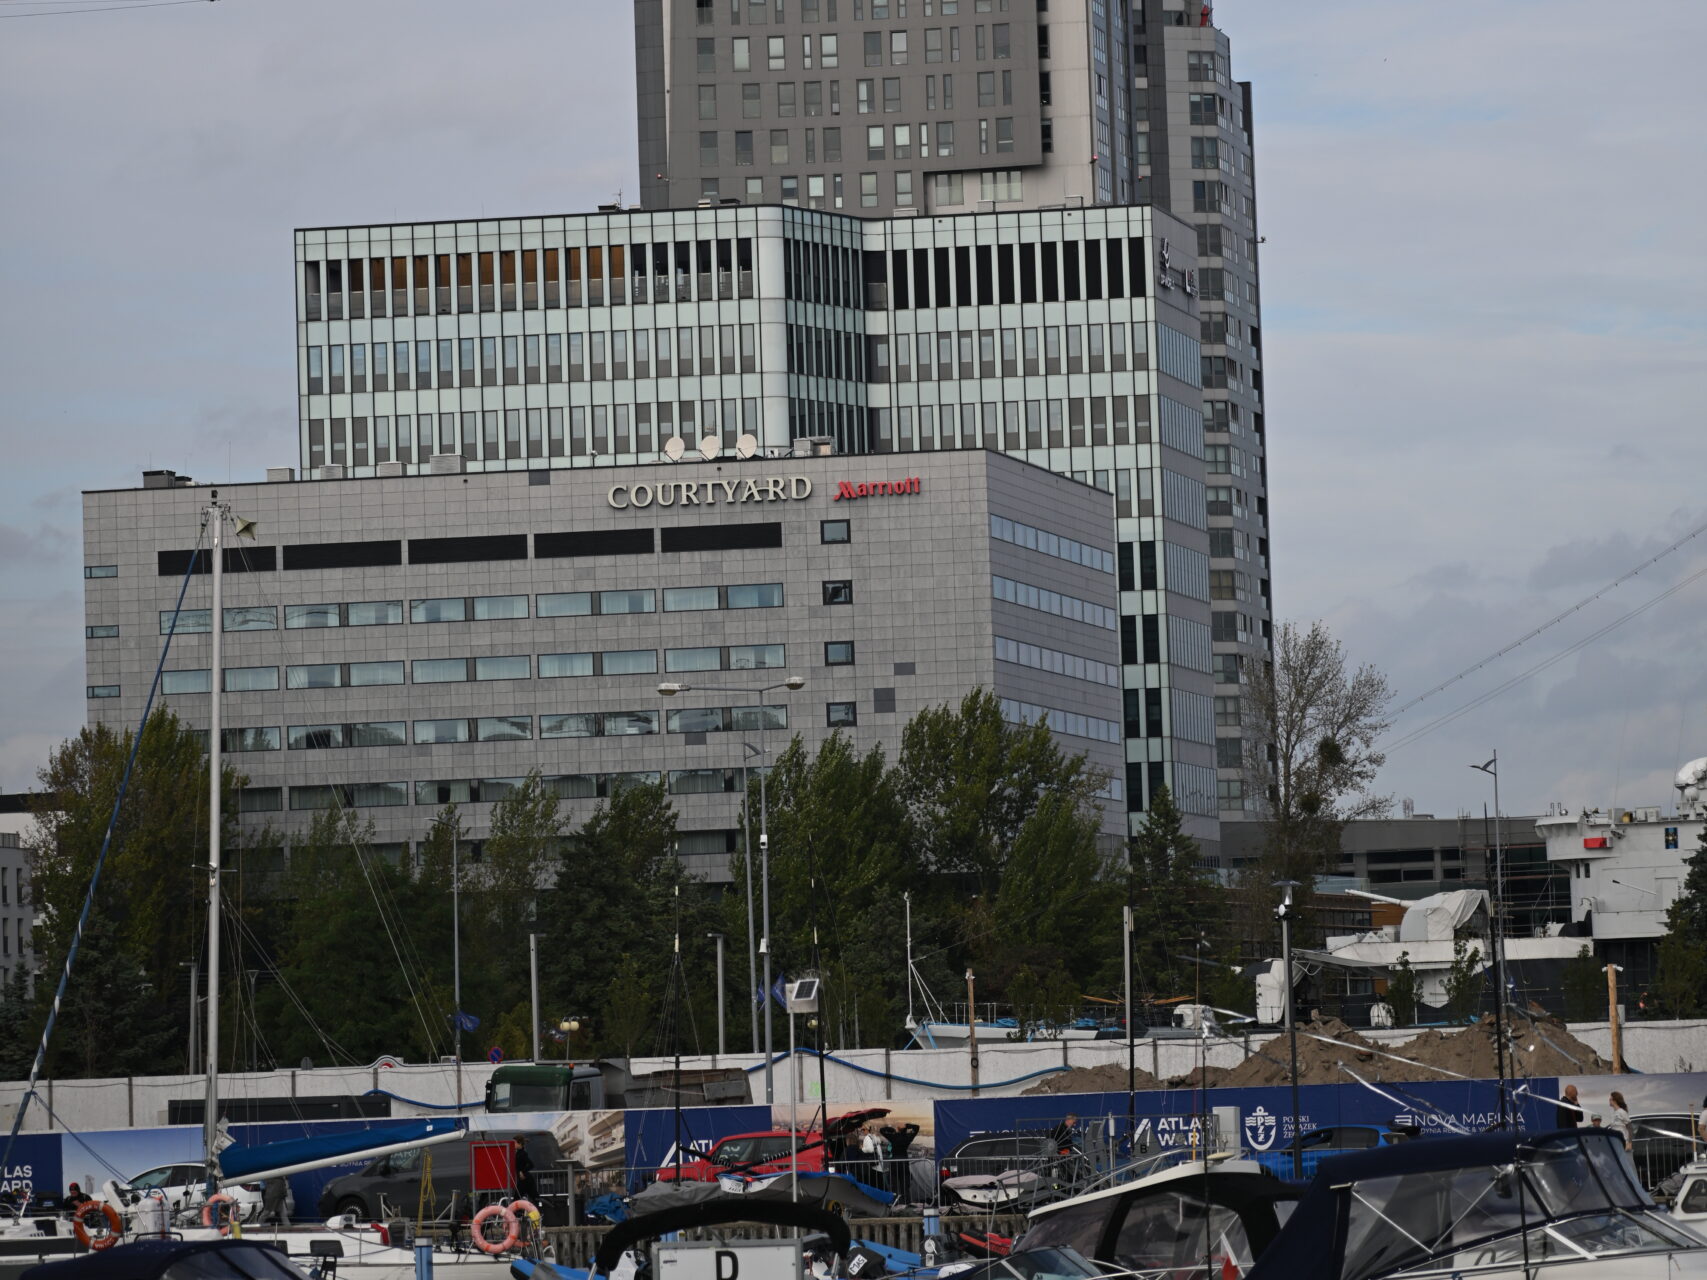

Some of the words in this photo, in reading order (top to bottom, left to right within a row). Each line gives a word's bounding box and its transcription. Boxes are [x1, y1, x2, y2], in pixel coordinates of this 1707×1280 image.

[607, 476, 812, 509] COURTYARD
[833, 476, 920, 502] Marriott
[0, 1165, 33, 1178] LAS
[715, 1250, 739, 1280] D
